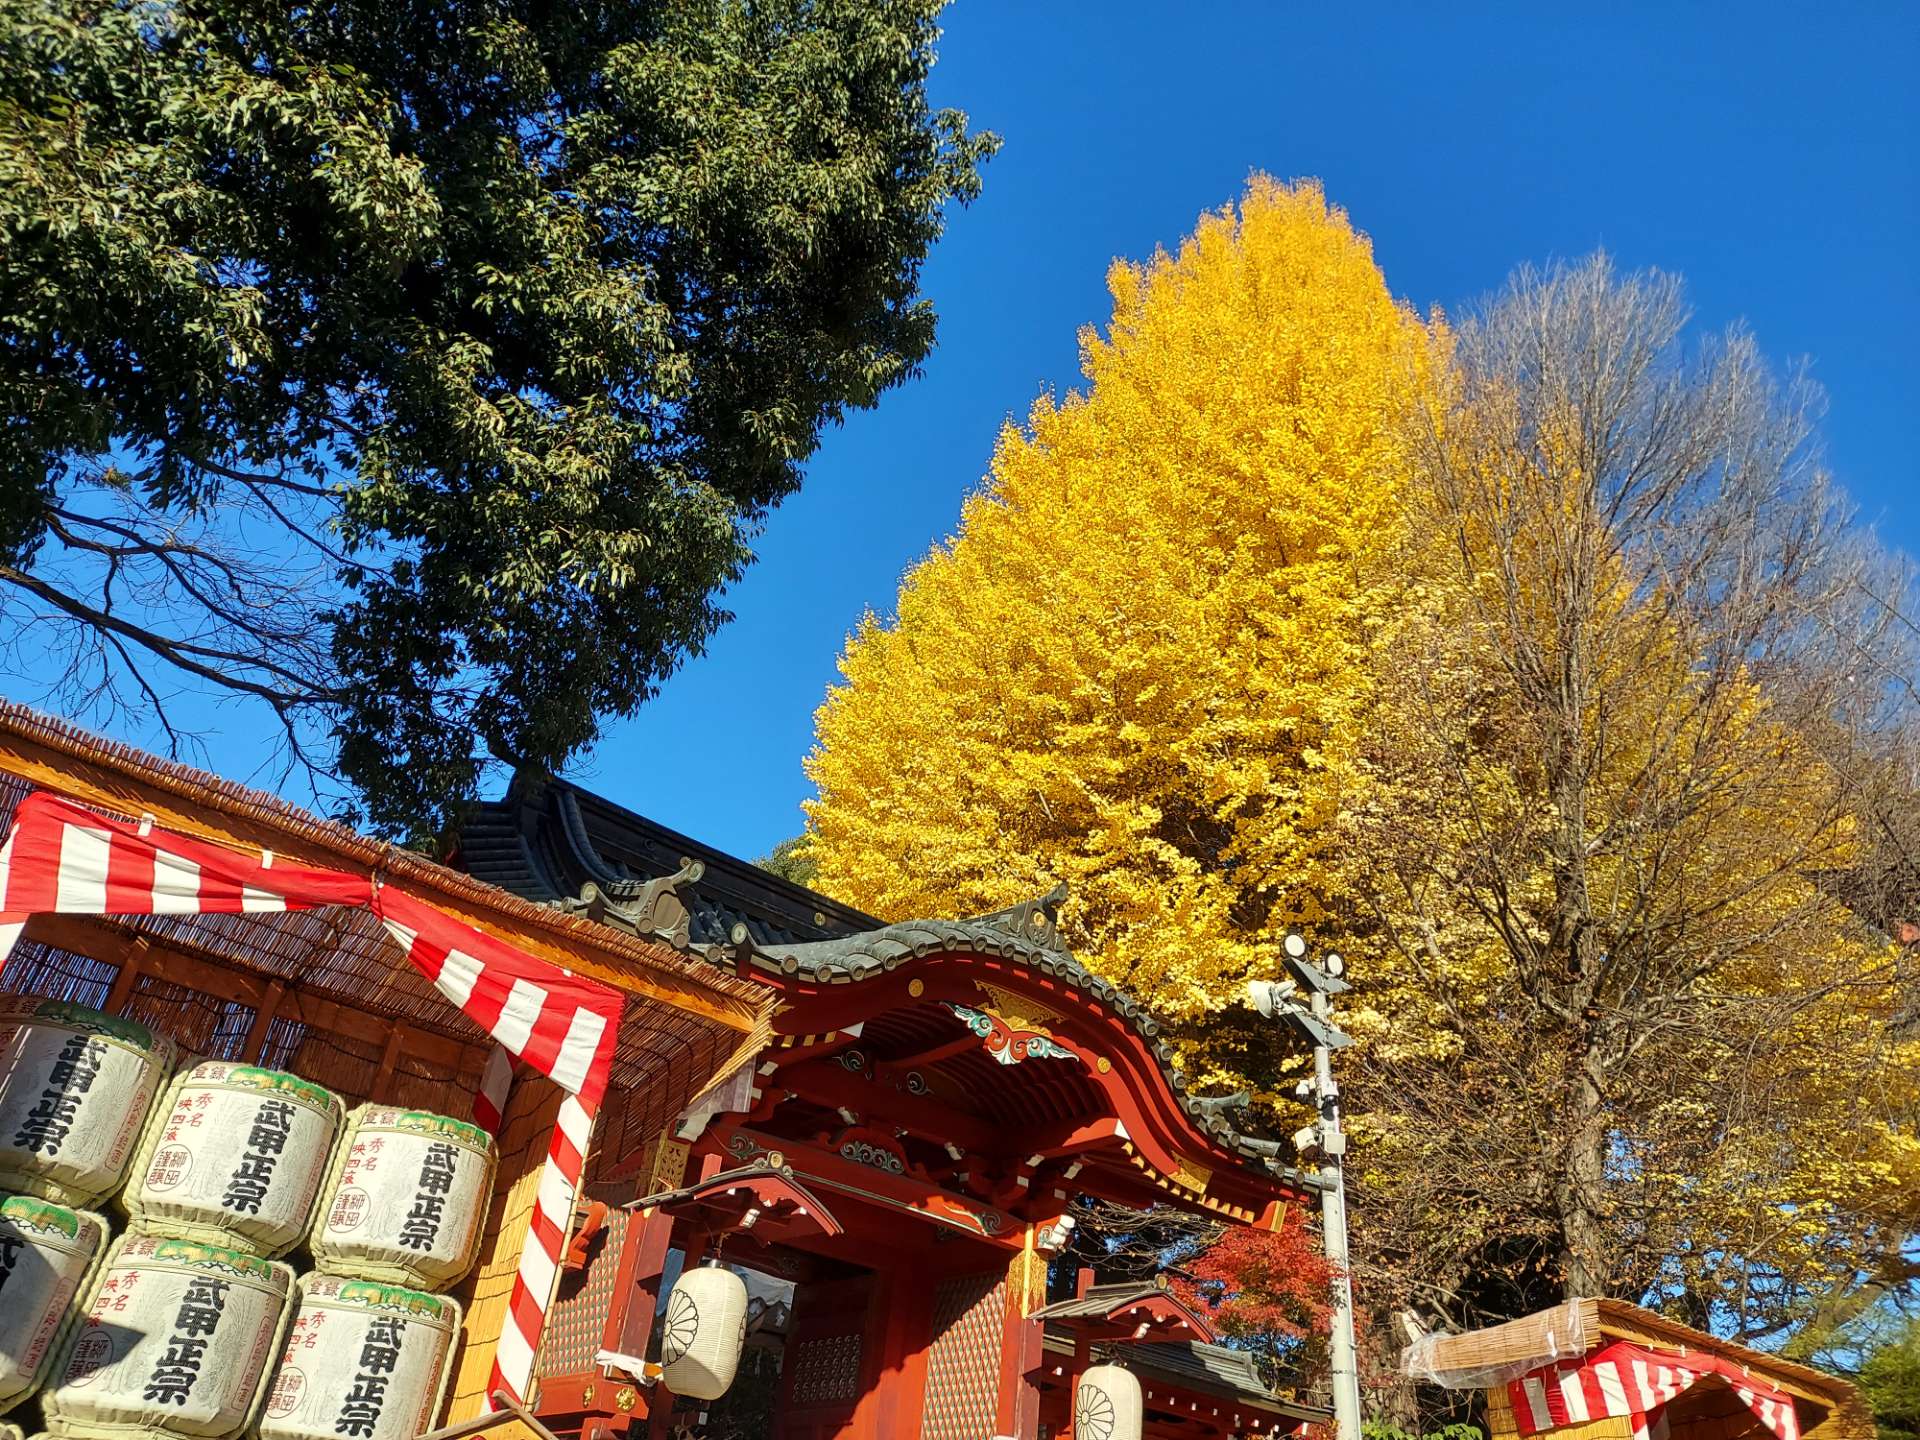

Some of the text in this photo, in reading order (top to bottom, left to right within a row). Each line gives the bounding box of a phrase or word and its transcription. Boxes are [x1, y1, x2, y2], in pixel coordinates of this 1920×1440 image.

[14, 1035, 109, 1156] 武甲正宗
[222, 1100, 297, 1215] 武甲正宗
[399, 1142, 461, 1252] 武甲正宗
[143, 1275, 231, 1406] 武甲正宗
[334, 1316, 408, 1438] 武甲正宗
